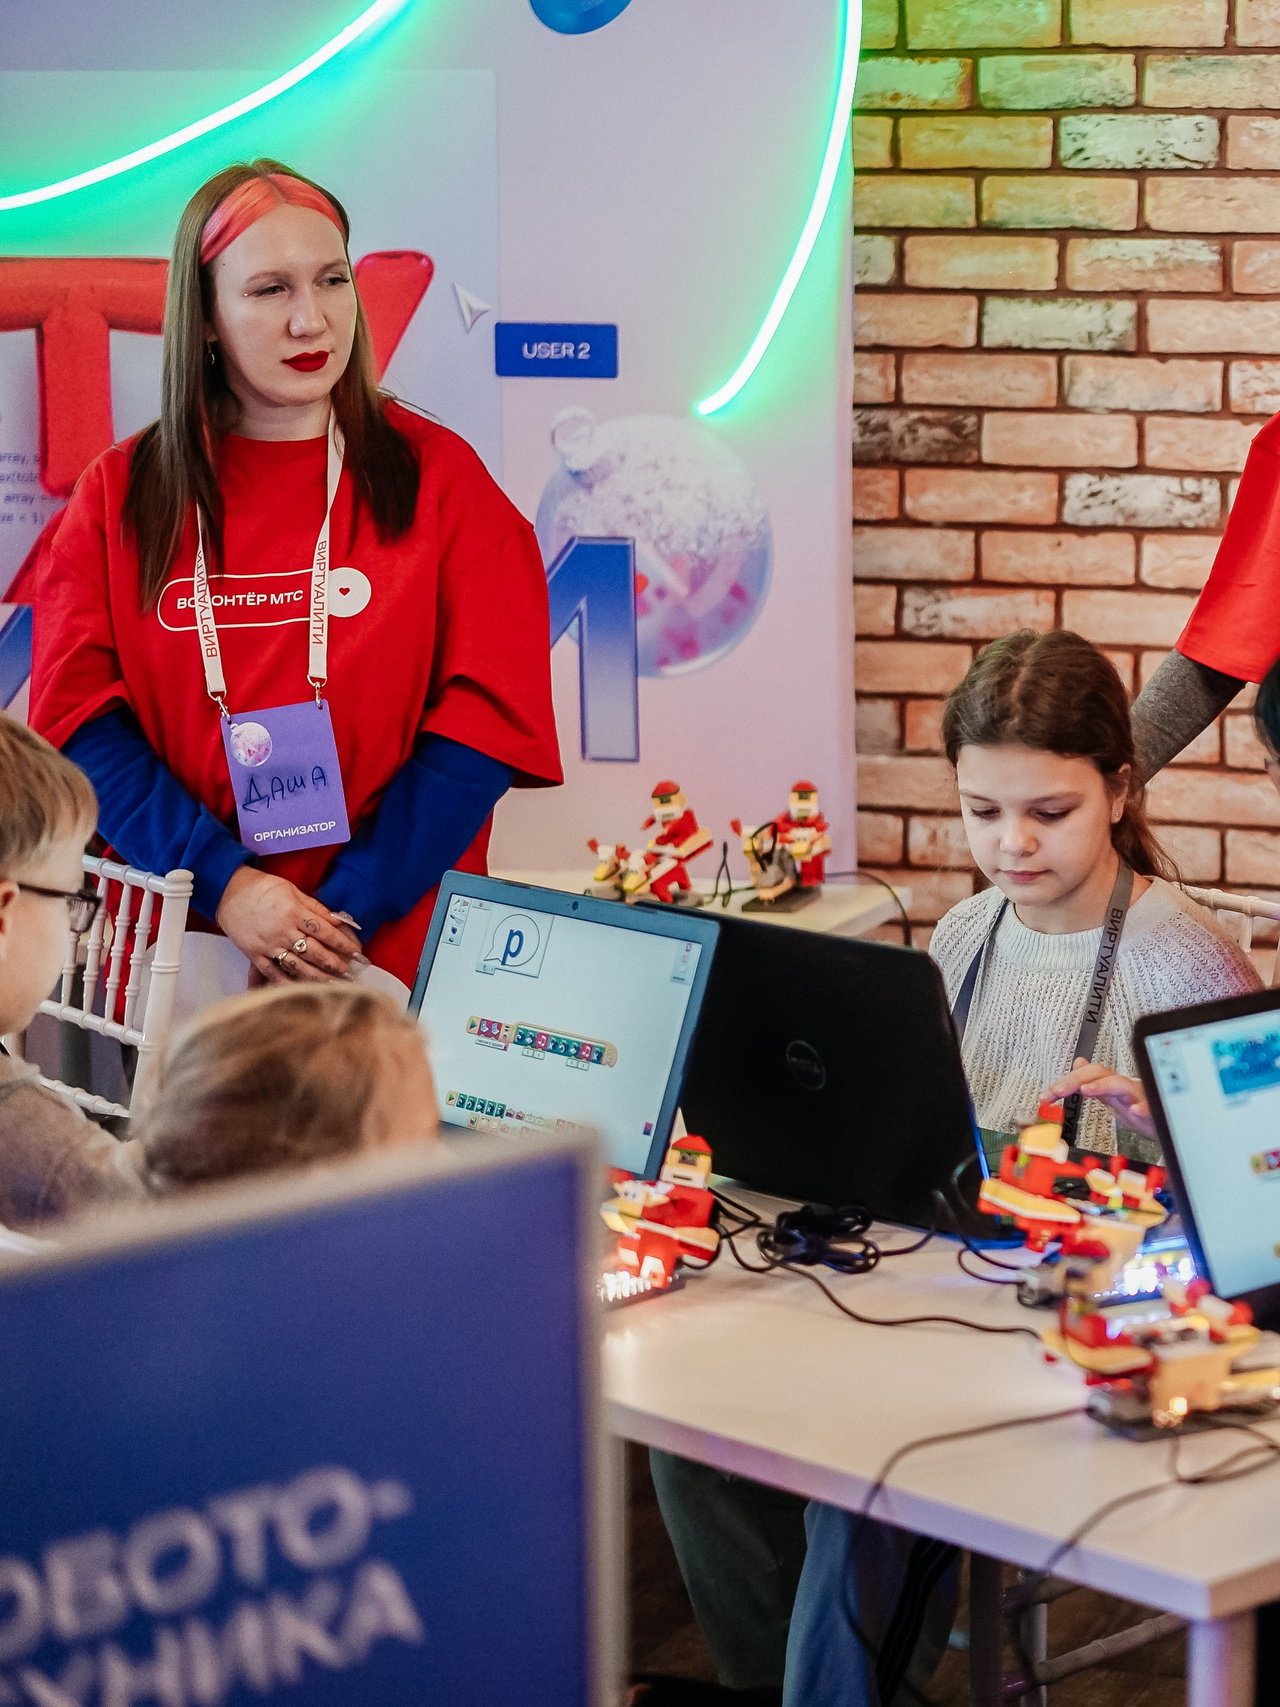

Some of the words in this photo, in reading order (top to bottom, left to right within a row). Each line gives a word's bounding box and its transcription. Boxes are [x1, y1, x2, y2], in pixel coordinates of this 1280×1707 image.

[522, 342, 575, 360] USER
[577, 342, 591, 360] 2
[176, 591, 267, 610] ВООНТЁР
[270, 589, 304, 605] МТС
[312, 540, 328, 645] ВИРТУАЛИТИ
[241, 765, 327, 813] ДАША
[253, 820, 337, 842] ОРГАНИЗАТОР
[1086, 907, 1124, 1024] ВИРТУАЛИТИ
